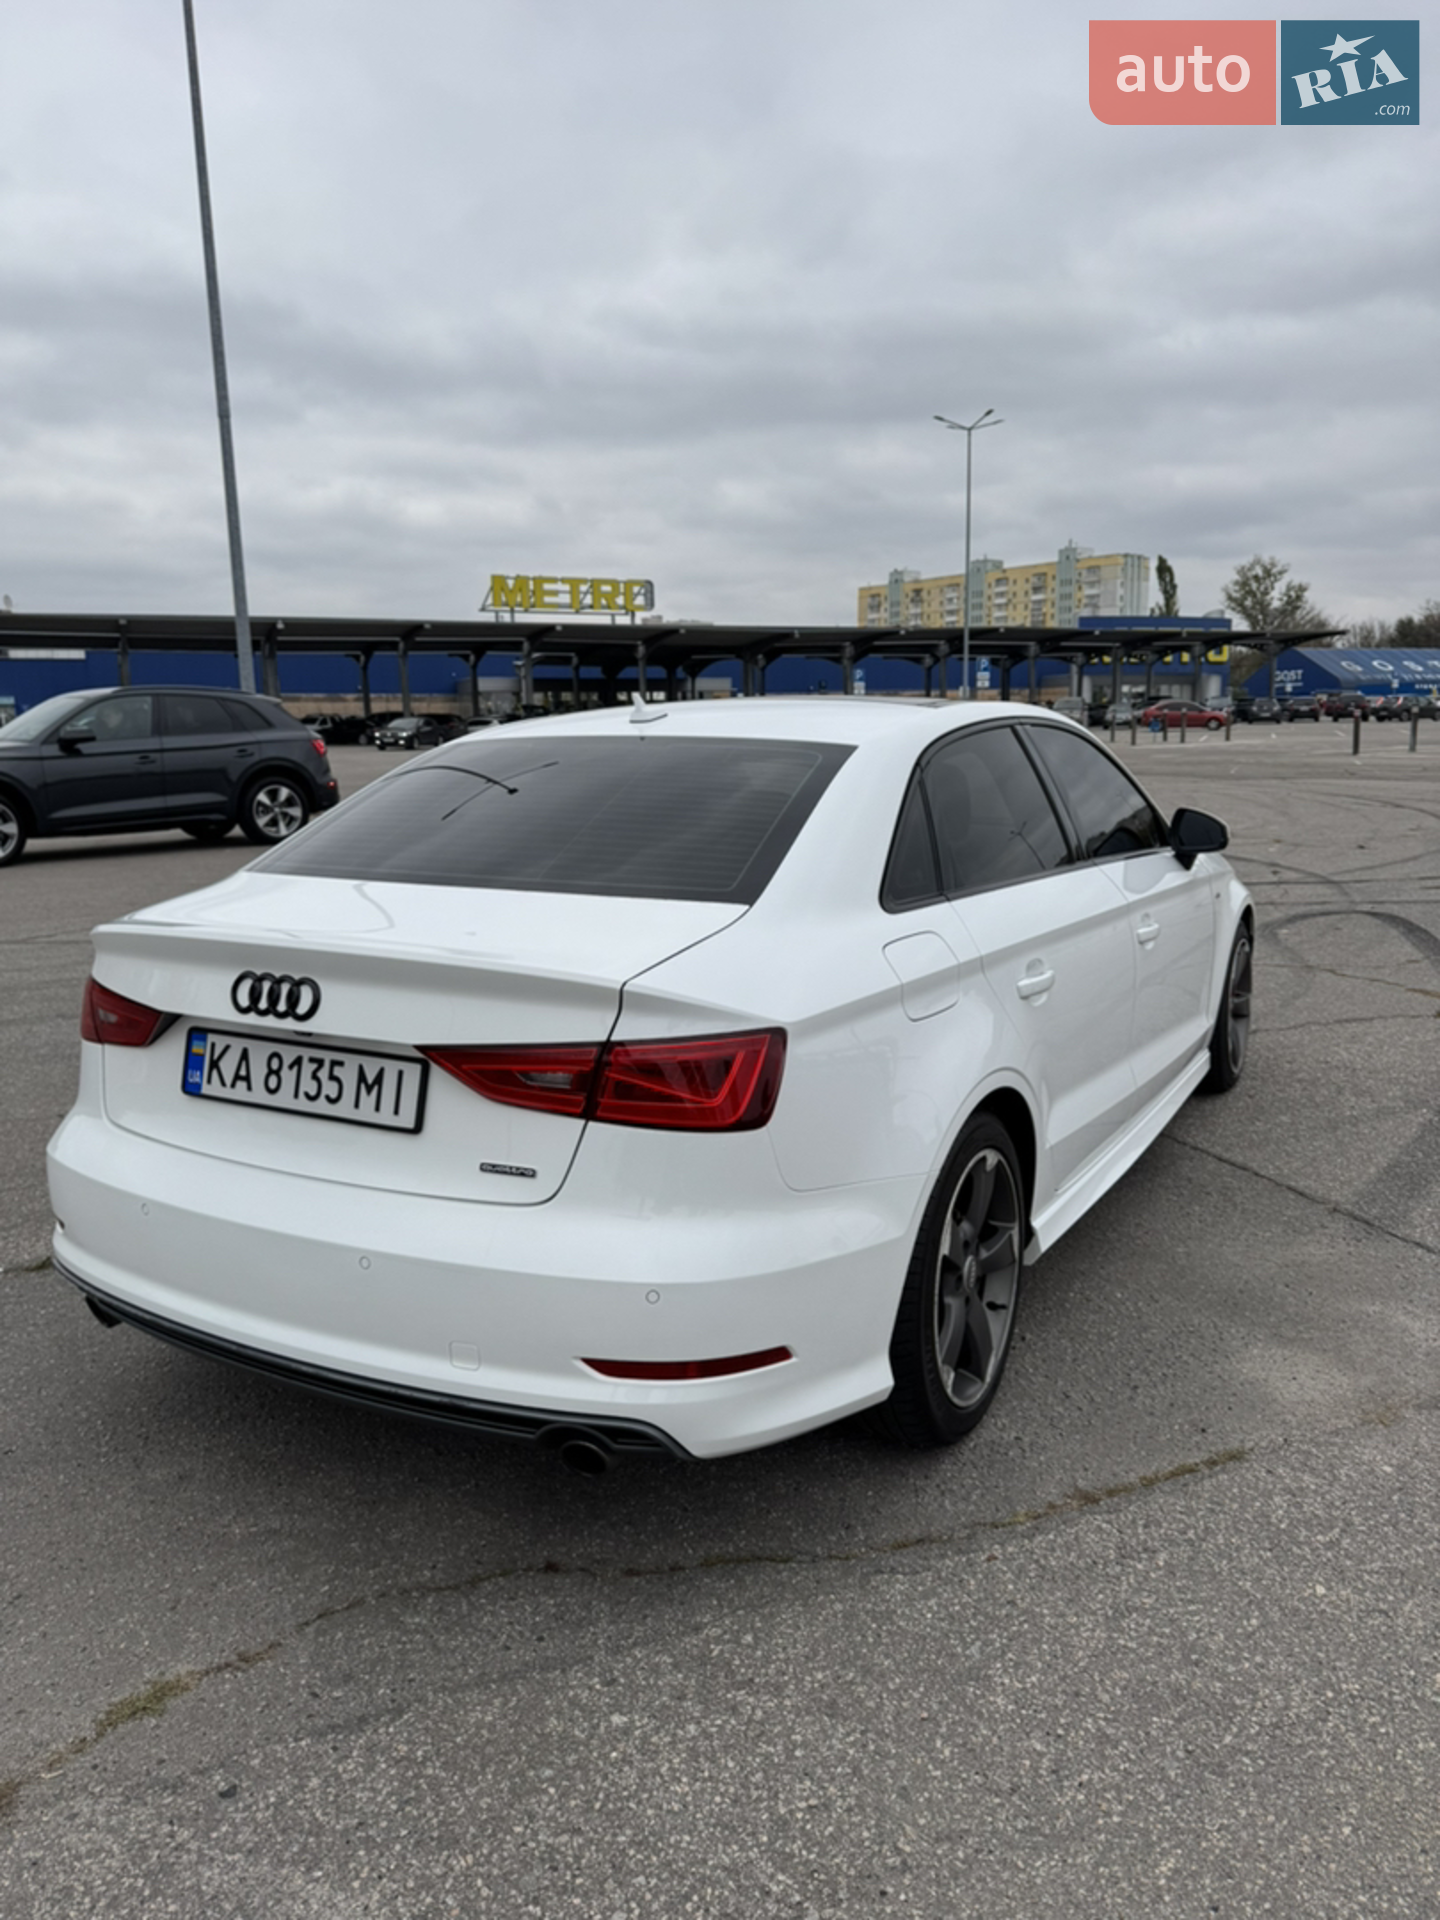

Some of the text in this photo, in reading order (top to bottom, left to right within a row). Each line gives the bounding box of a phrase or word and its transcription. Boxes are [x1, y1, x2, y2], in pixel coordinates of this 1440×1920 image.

[491, 574, 655, 612] METRO
[187, 1069, 202, 1084] UA
[206, 1041, 404, 1116] KA 8135 MI
